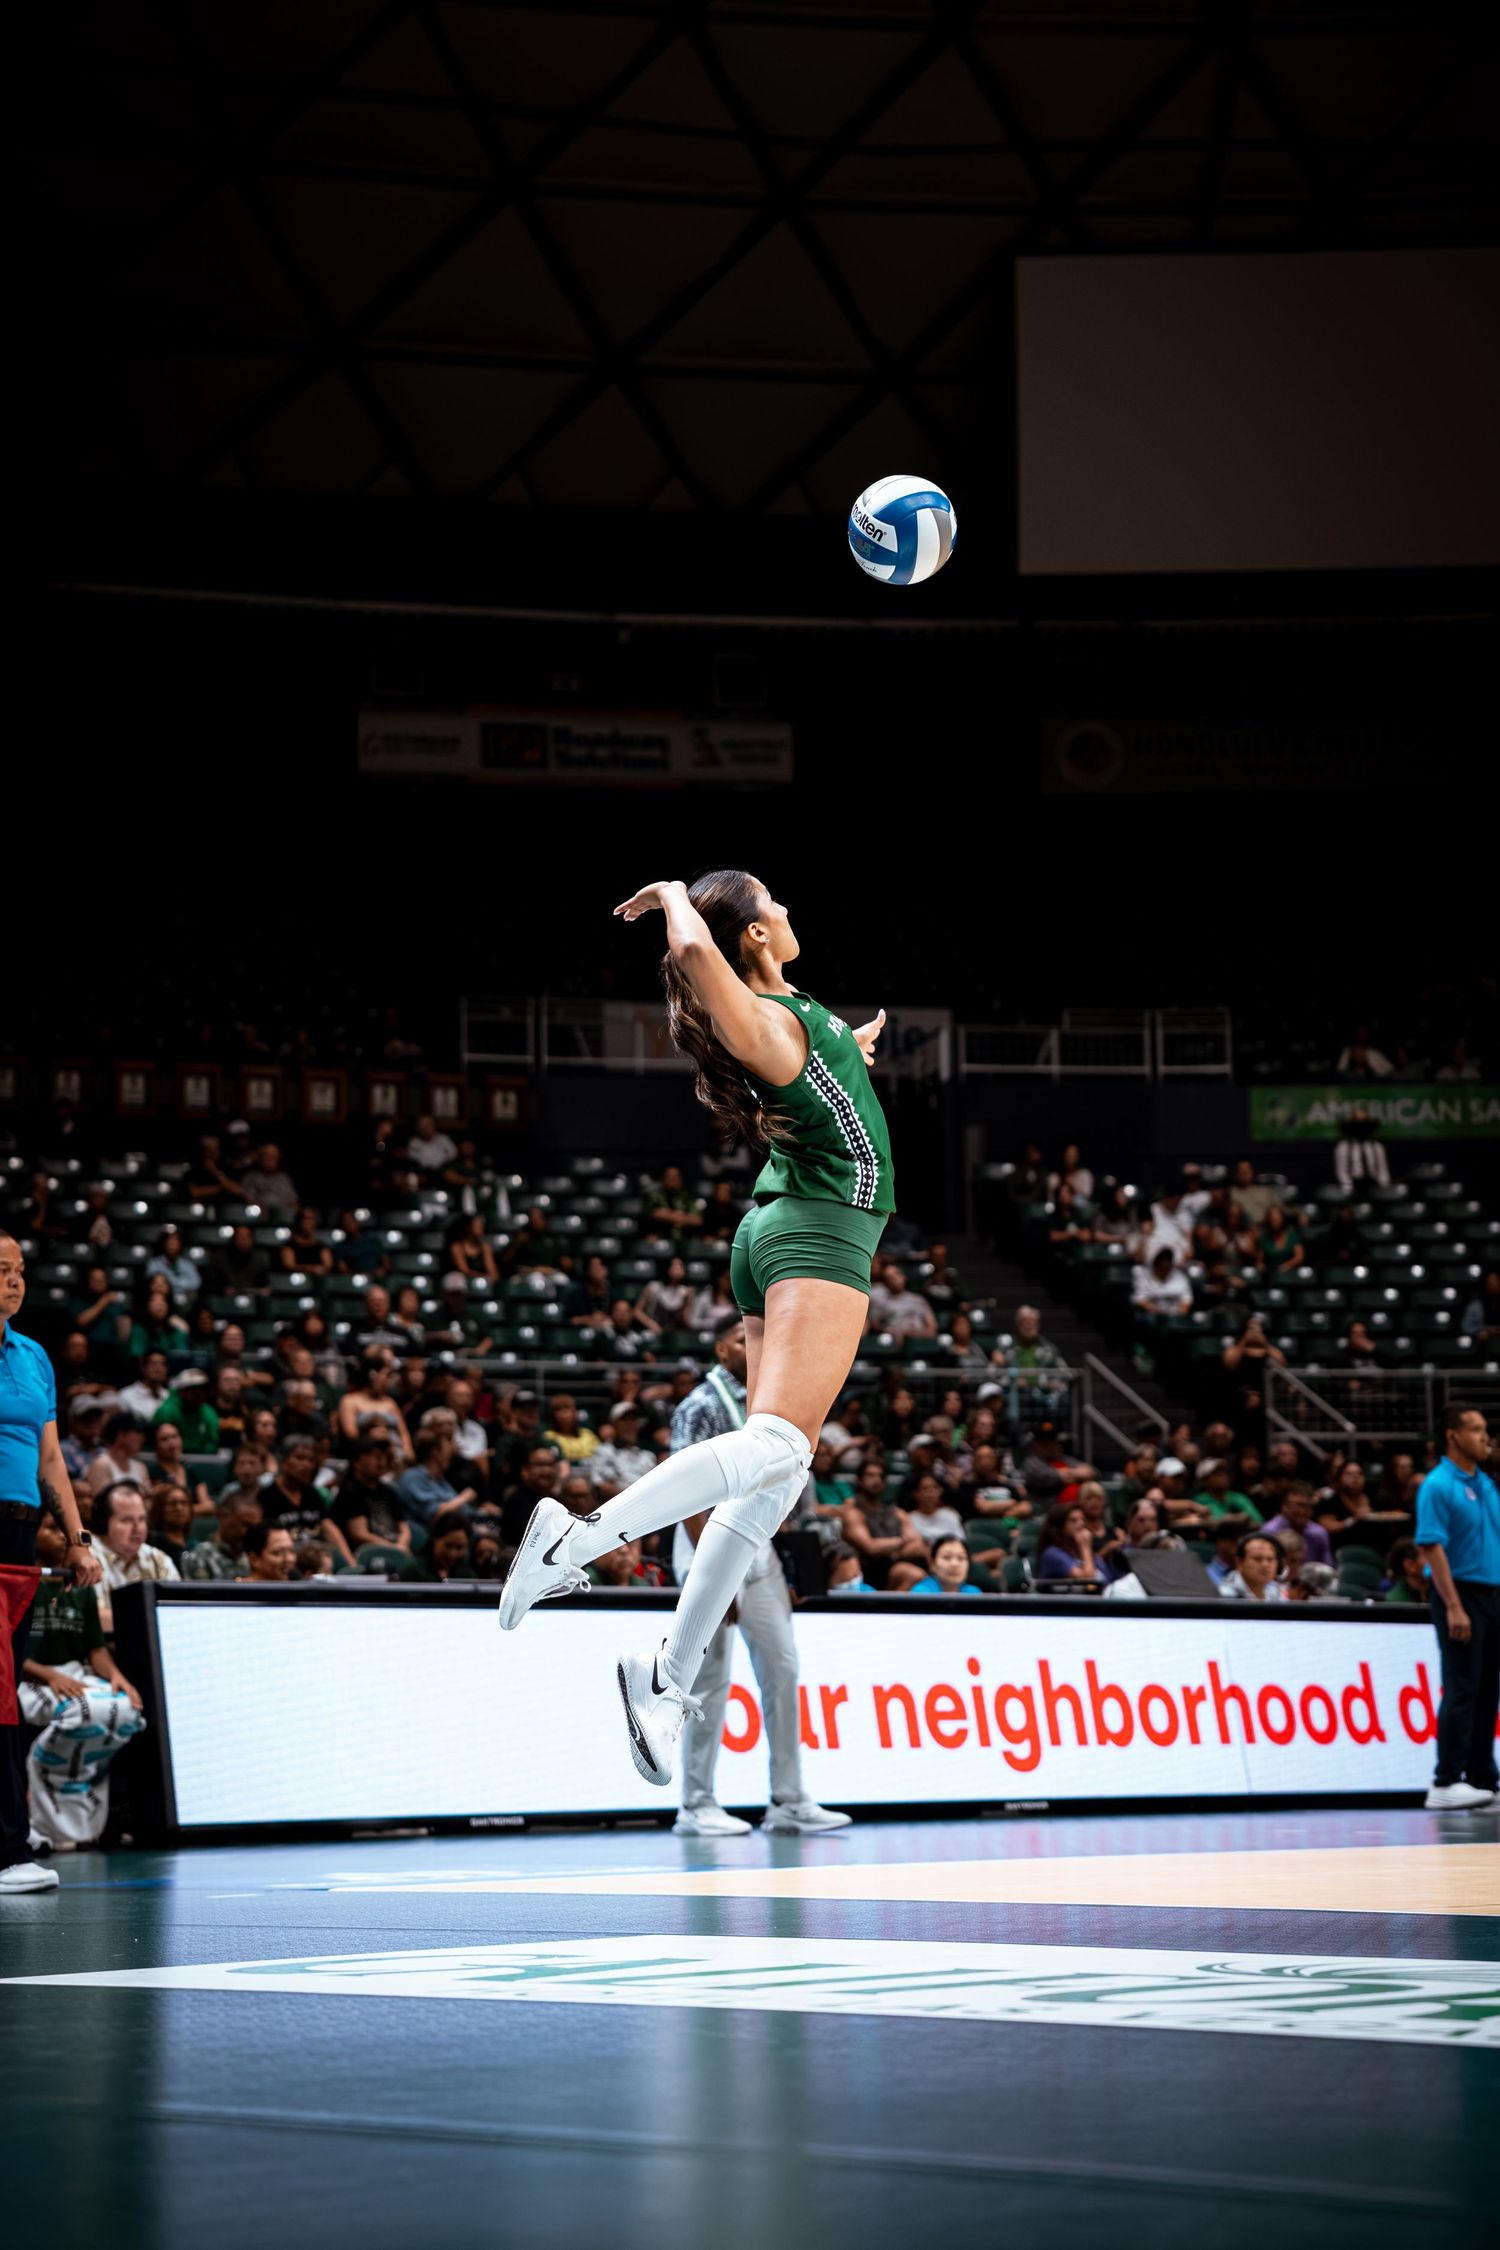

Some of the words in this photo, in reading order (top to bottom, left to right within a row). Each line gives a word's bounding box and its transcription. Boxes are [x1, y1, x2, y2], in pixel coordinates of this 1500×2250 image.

[1307, 1099, 1461, 1126] AMERICAN
[873, 1656, 1387, 1773] neighborhood
[1115, 2011, 1500, 2040] VEGA
